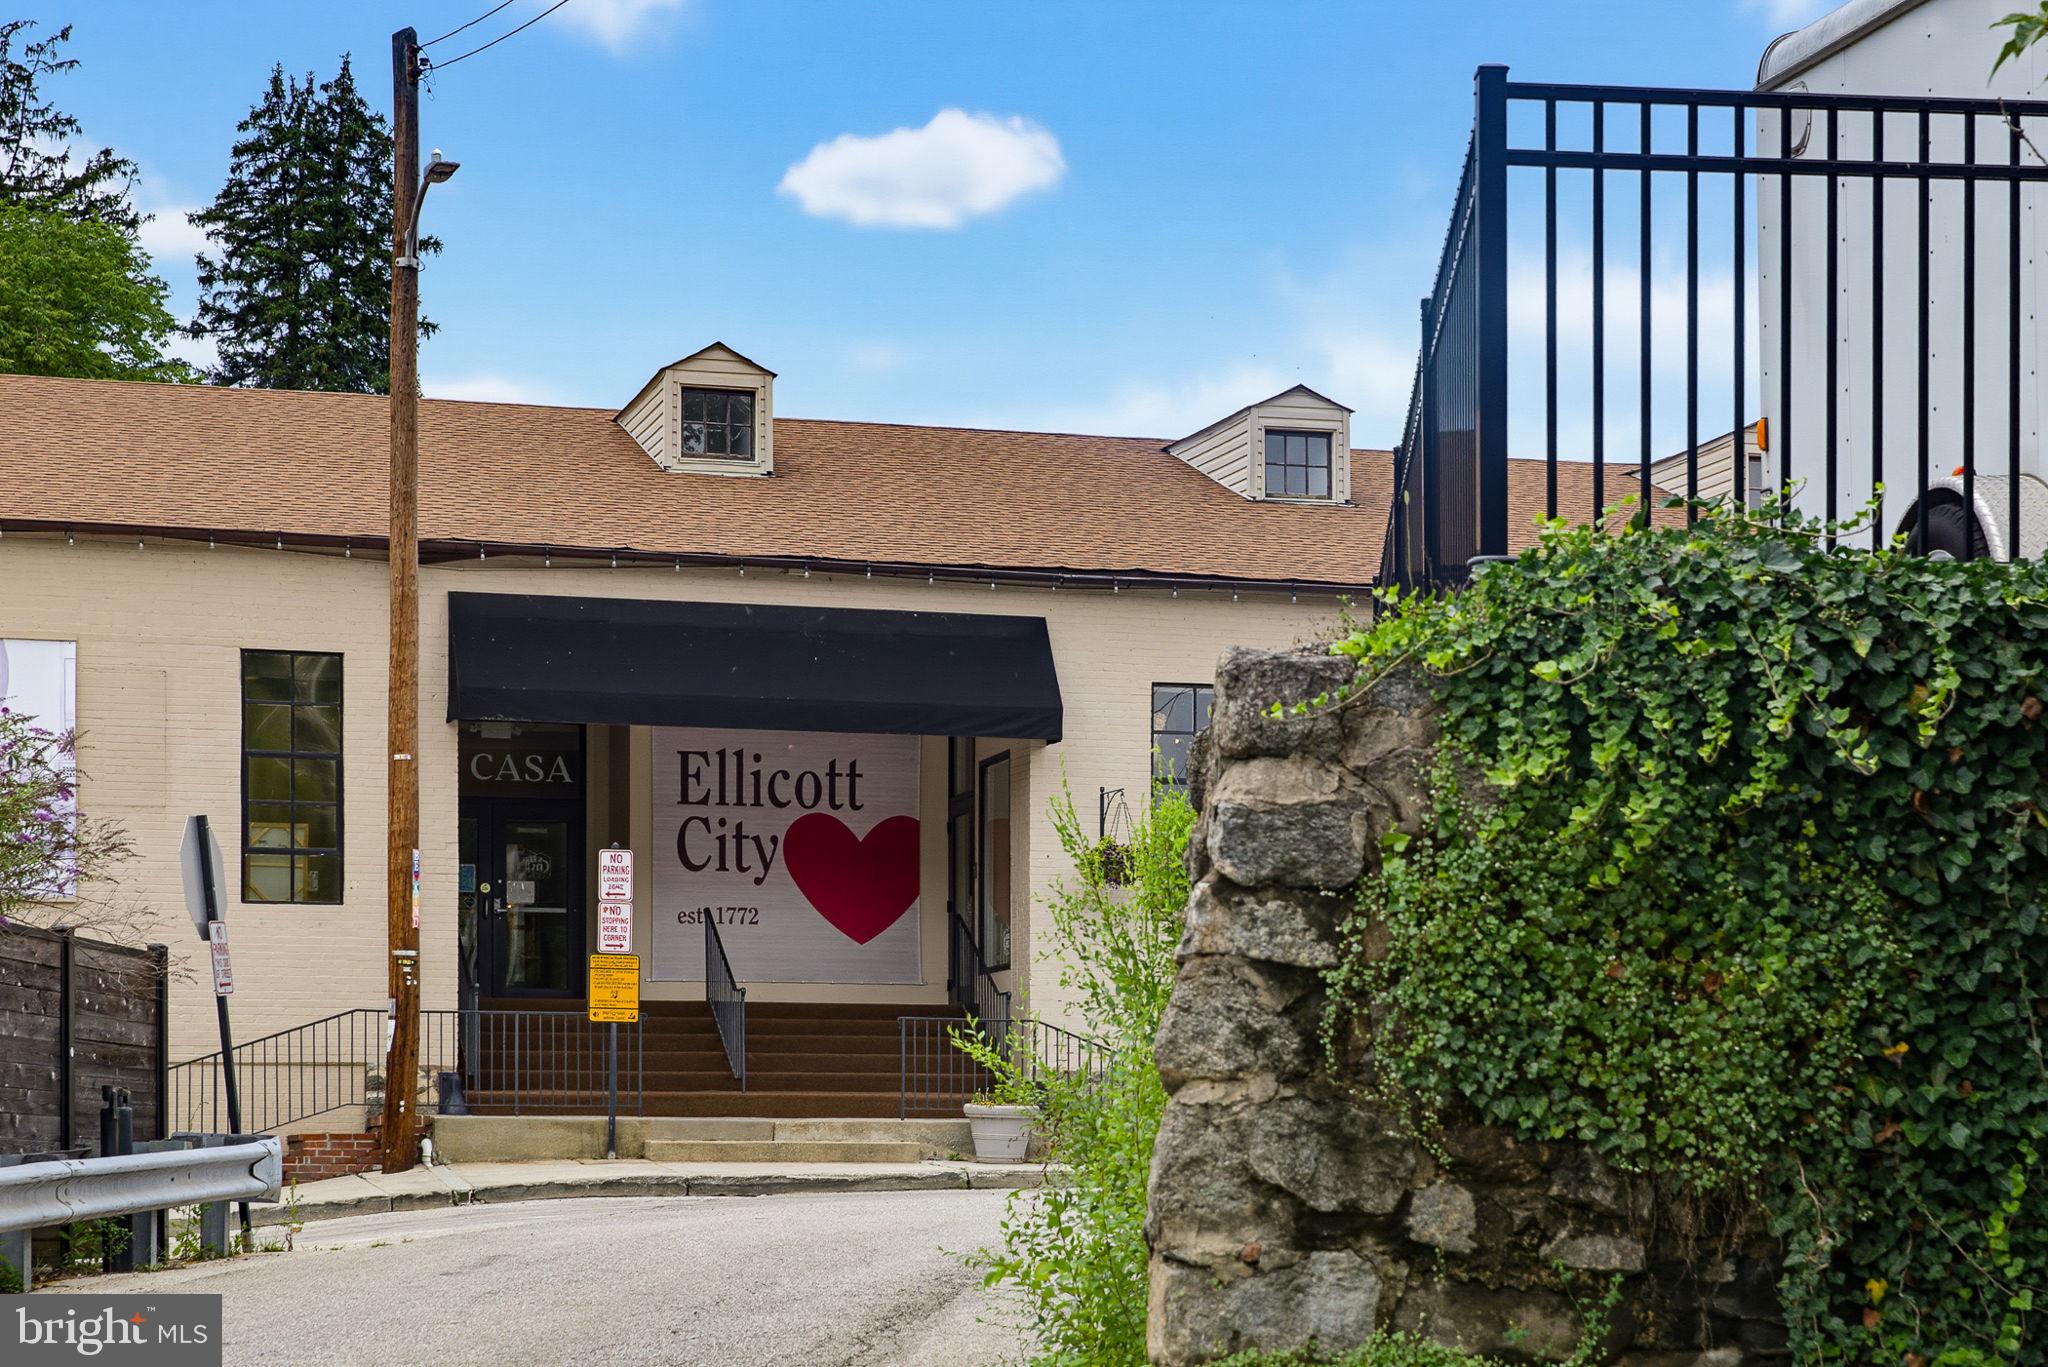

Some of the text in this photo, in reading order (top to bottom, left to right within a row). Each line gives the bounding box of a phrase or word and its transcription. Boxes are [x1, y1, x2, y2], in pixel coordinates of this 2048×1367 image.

[470, 753, 574, 783] CASA
[676, 748, 864, 811] Ellicott
[676, 815, 779, 886] City
[609, 853, 623, 864] NO
[602, 865, 630, 875] PARKING
[609, 906, 622, 916] NO
[716, 907, 759, 925] 1772
[602, 917, 629, 925] STOPPING
[602, 925, 628, 933] HERE TO
[603, 934, 627, 942] CORNER
